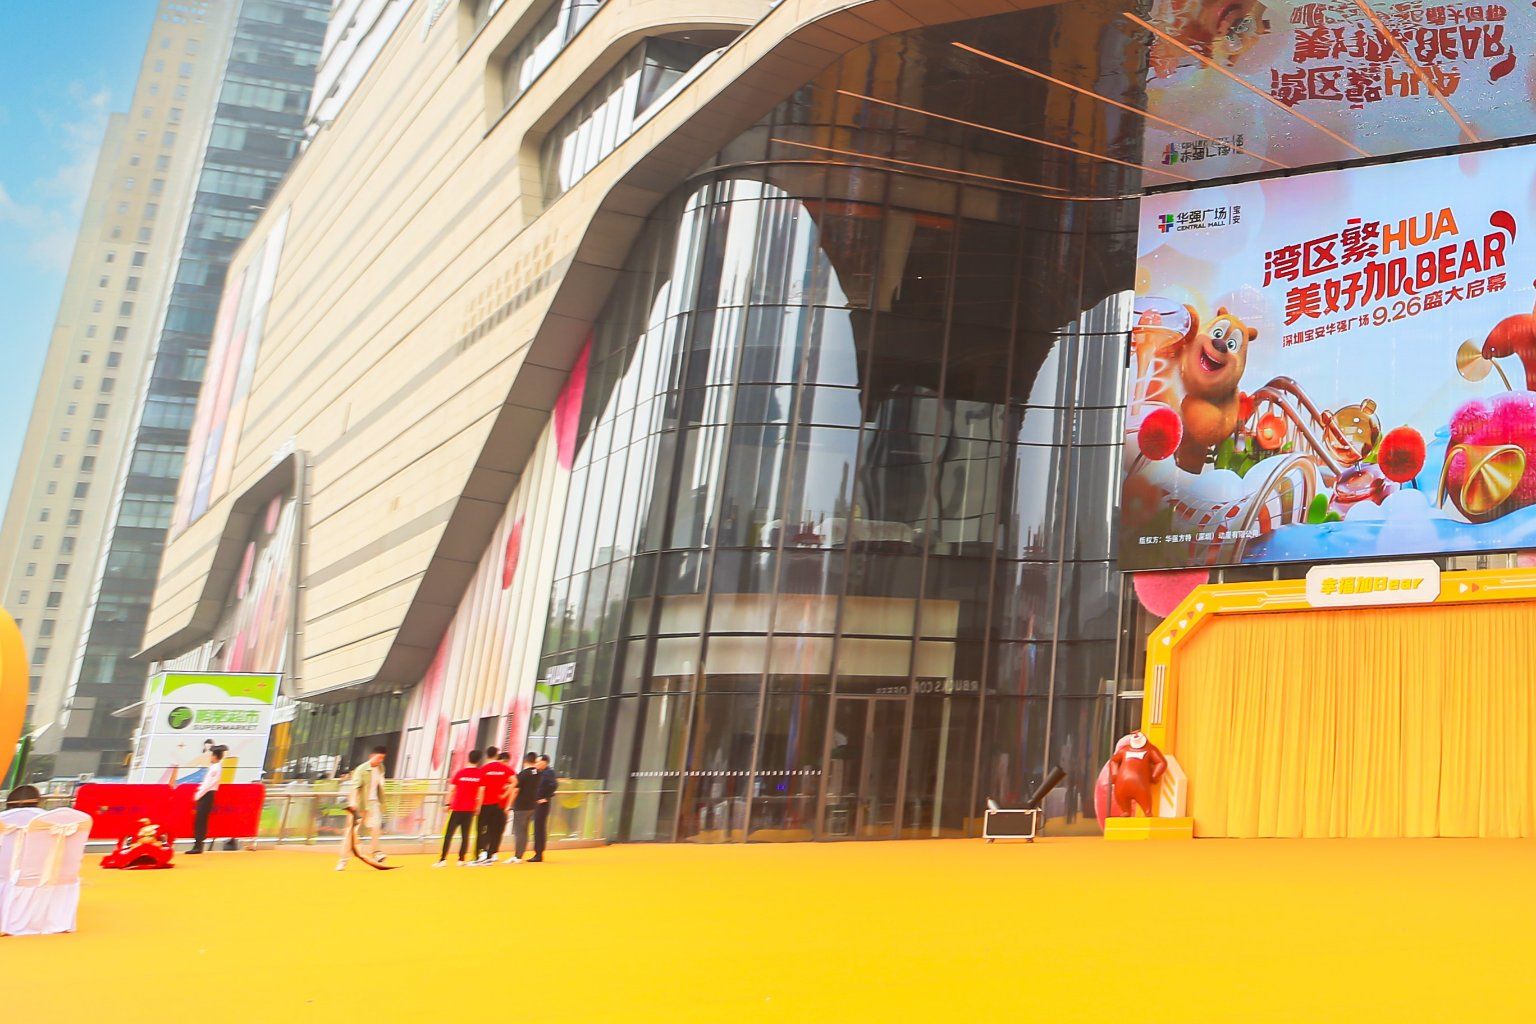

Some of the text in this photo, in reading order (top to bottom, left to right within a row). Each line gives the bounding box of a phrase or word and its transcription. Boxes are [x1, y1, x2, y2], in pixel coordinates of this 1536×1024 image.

[1176, 207, 1227, 225] 华强广场
[1176, 223, 1206, 232] CENTRAL
[1282, 313, 1370, 348] 深圳宝安华强广场
[1321, 576, 1424, 595] 幸福加Bear
